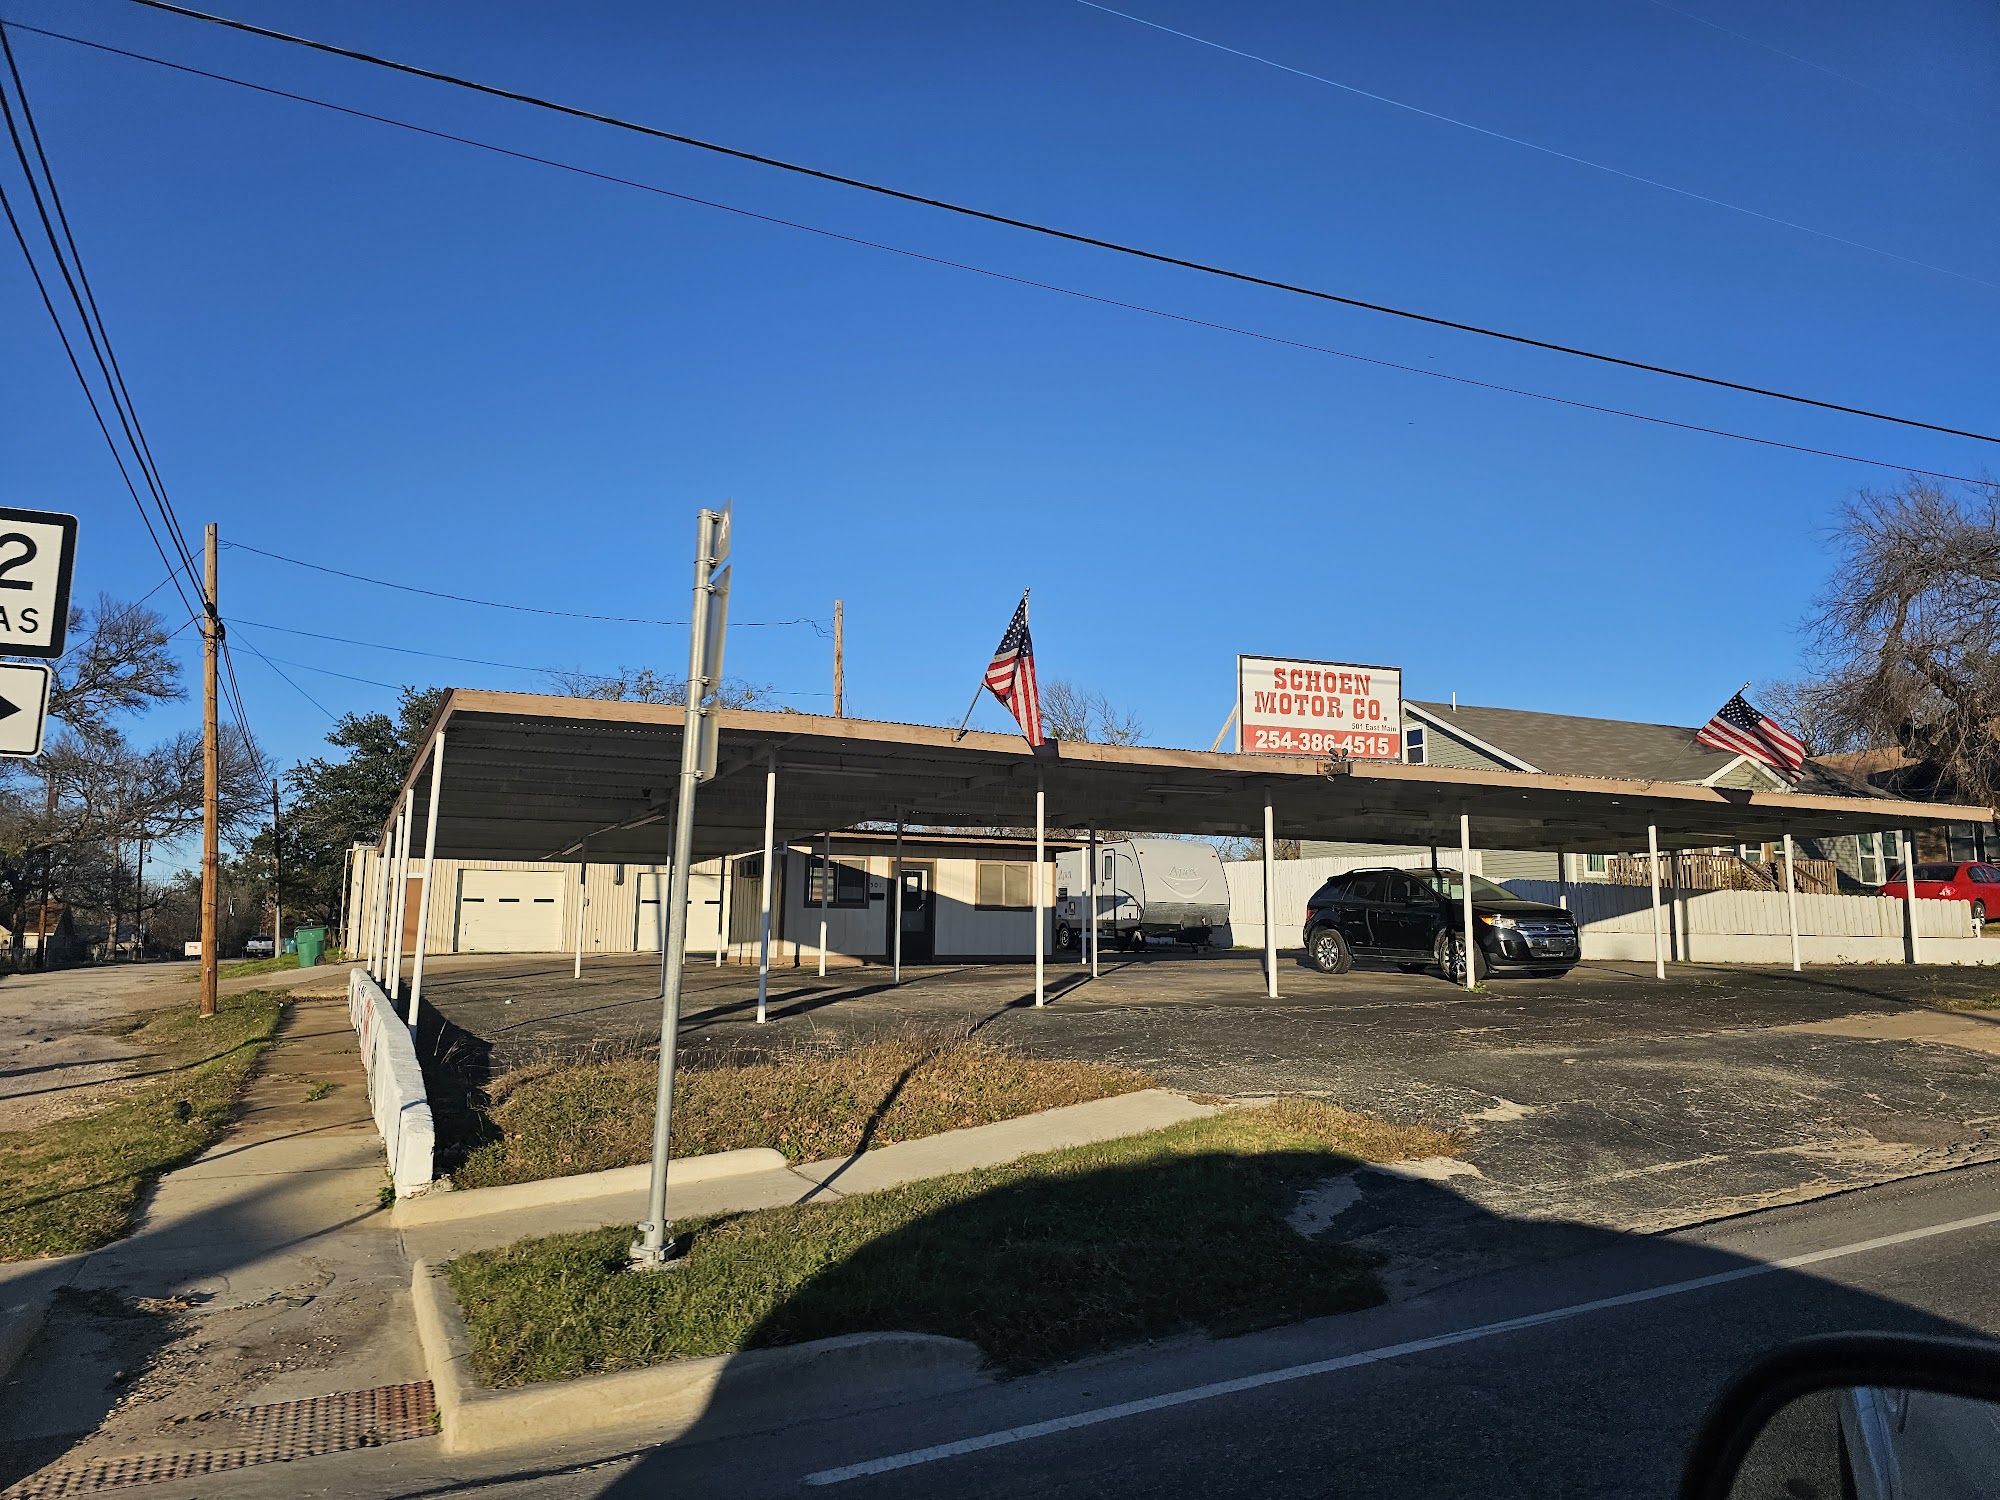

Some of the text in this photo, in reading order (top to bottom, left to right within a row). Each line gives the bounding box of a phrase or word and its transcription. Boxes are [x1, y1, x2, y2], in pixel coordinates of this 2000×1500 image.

[0, 532, 37, 590] 2
[1274, 667, 1371, 696] SCHOEN
[1254, 691, 1388, 721] MOTOR CO.
[1365, 723, 1380, 731] East
[1381, 724, 1397, 732] Main
[1255, 730, 1389, 755] 254-386-4515
